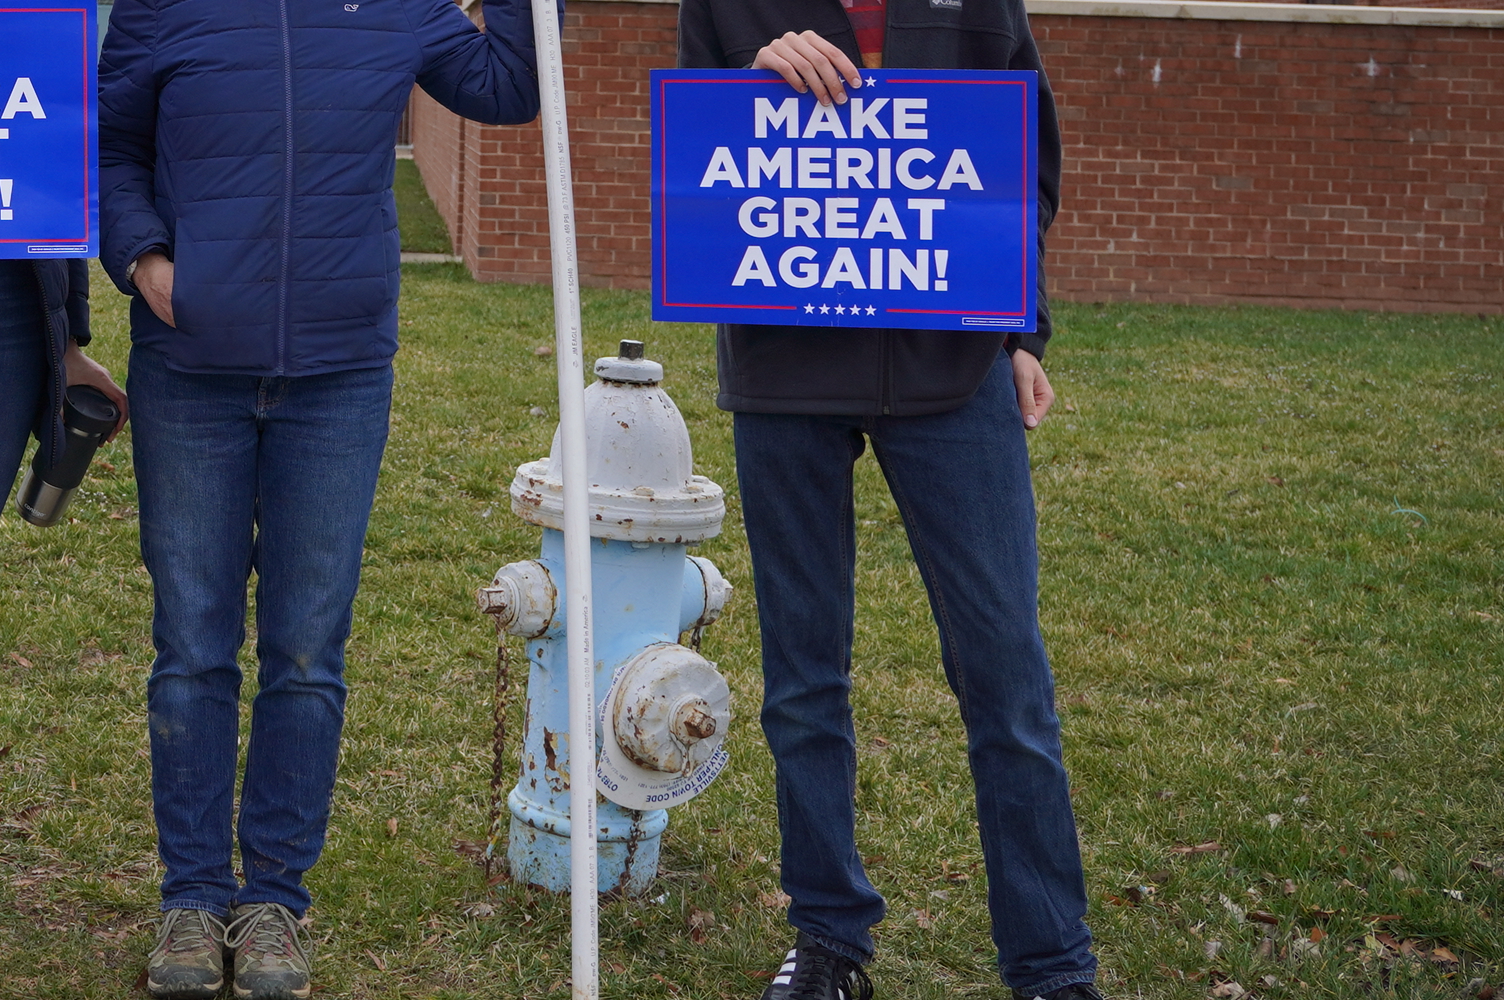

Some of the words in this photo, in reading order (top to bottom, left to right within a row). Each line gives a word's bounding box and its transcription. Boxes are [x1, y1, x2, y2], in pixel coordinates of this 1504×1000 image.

[754, 97, 928, 139] MAKE
[557, 142, 565, 154] NSF
[699, 146, 984, 191] AMERICA
[738, 196, 945, 240] GREAT
[565, 236, 573, 262] PVC1120
[731, 245, 949, 292] AGAIN!
[24, 503, 46, 517] contigo
[646, 793, 670, 803] CODE
[672, 780, 696, 798] TOWN
